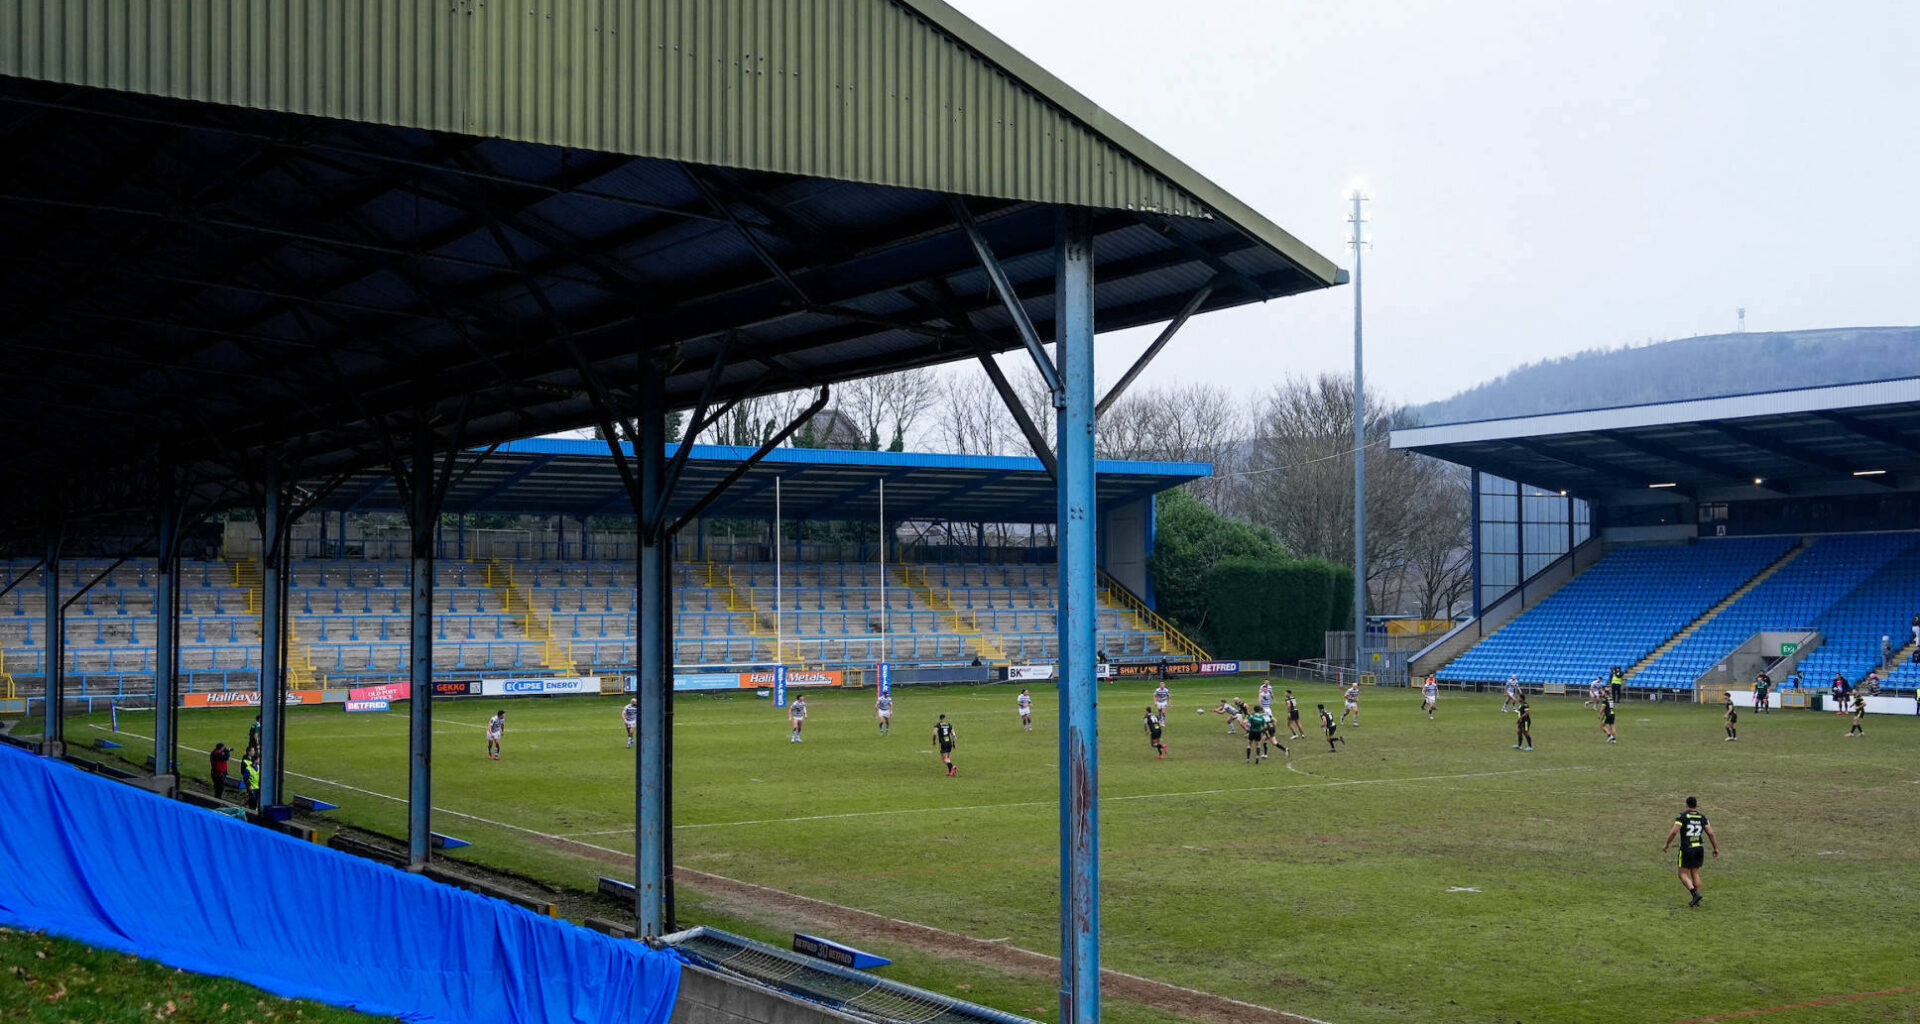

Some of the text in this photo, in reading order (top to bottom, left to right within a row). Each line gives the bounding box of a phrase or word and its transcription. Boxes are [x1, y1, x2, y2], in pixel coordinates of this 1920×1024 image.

[1120, 666, 1138, 674] SHAY
[1201, 663, 1236, 672] BETFRED
[1010, 668, 1023, 678] BK
[437, 683, 465, 692] GEKKO
[506, 681, 578, 691] ECLIPSE ENERGY
[348, 700, 387, 710] BETFRED
[1685, 824, 1702, 837] 22
[817, 943, 828, 959] 30
